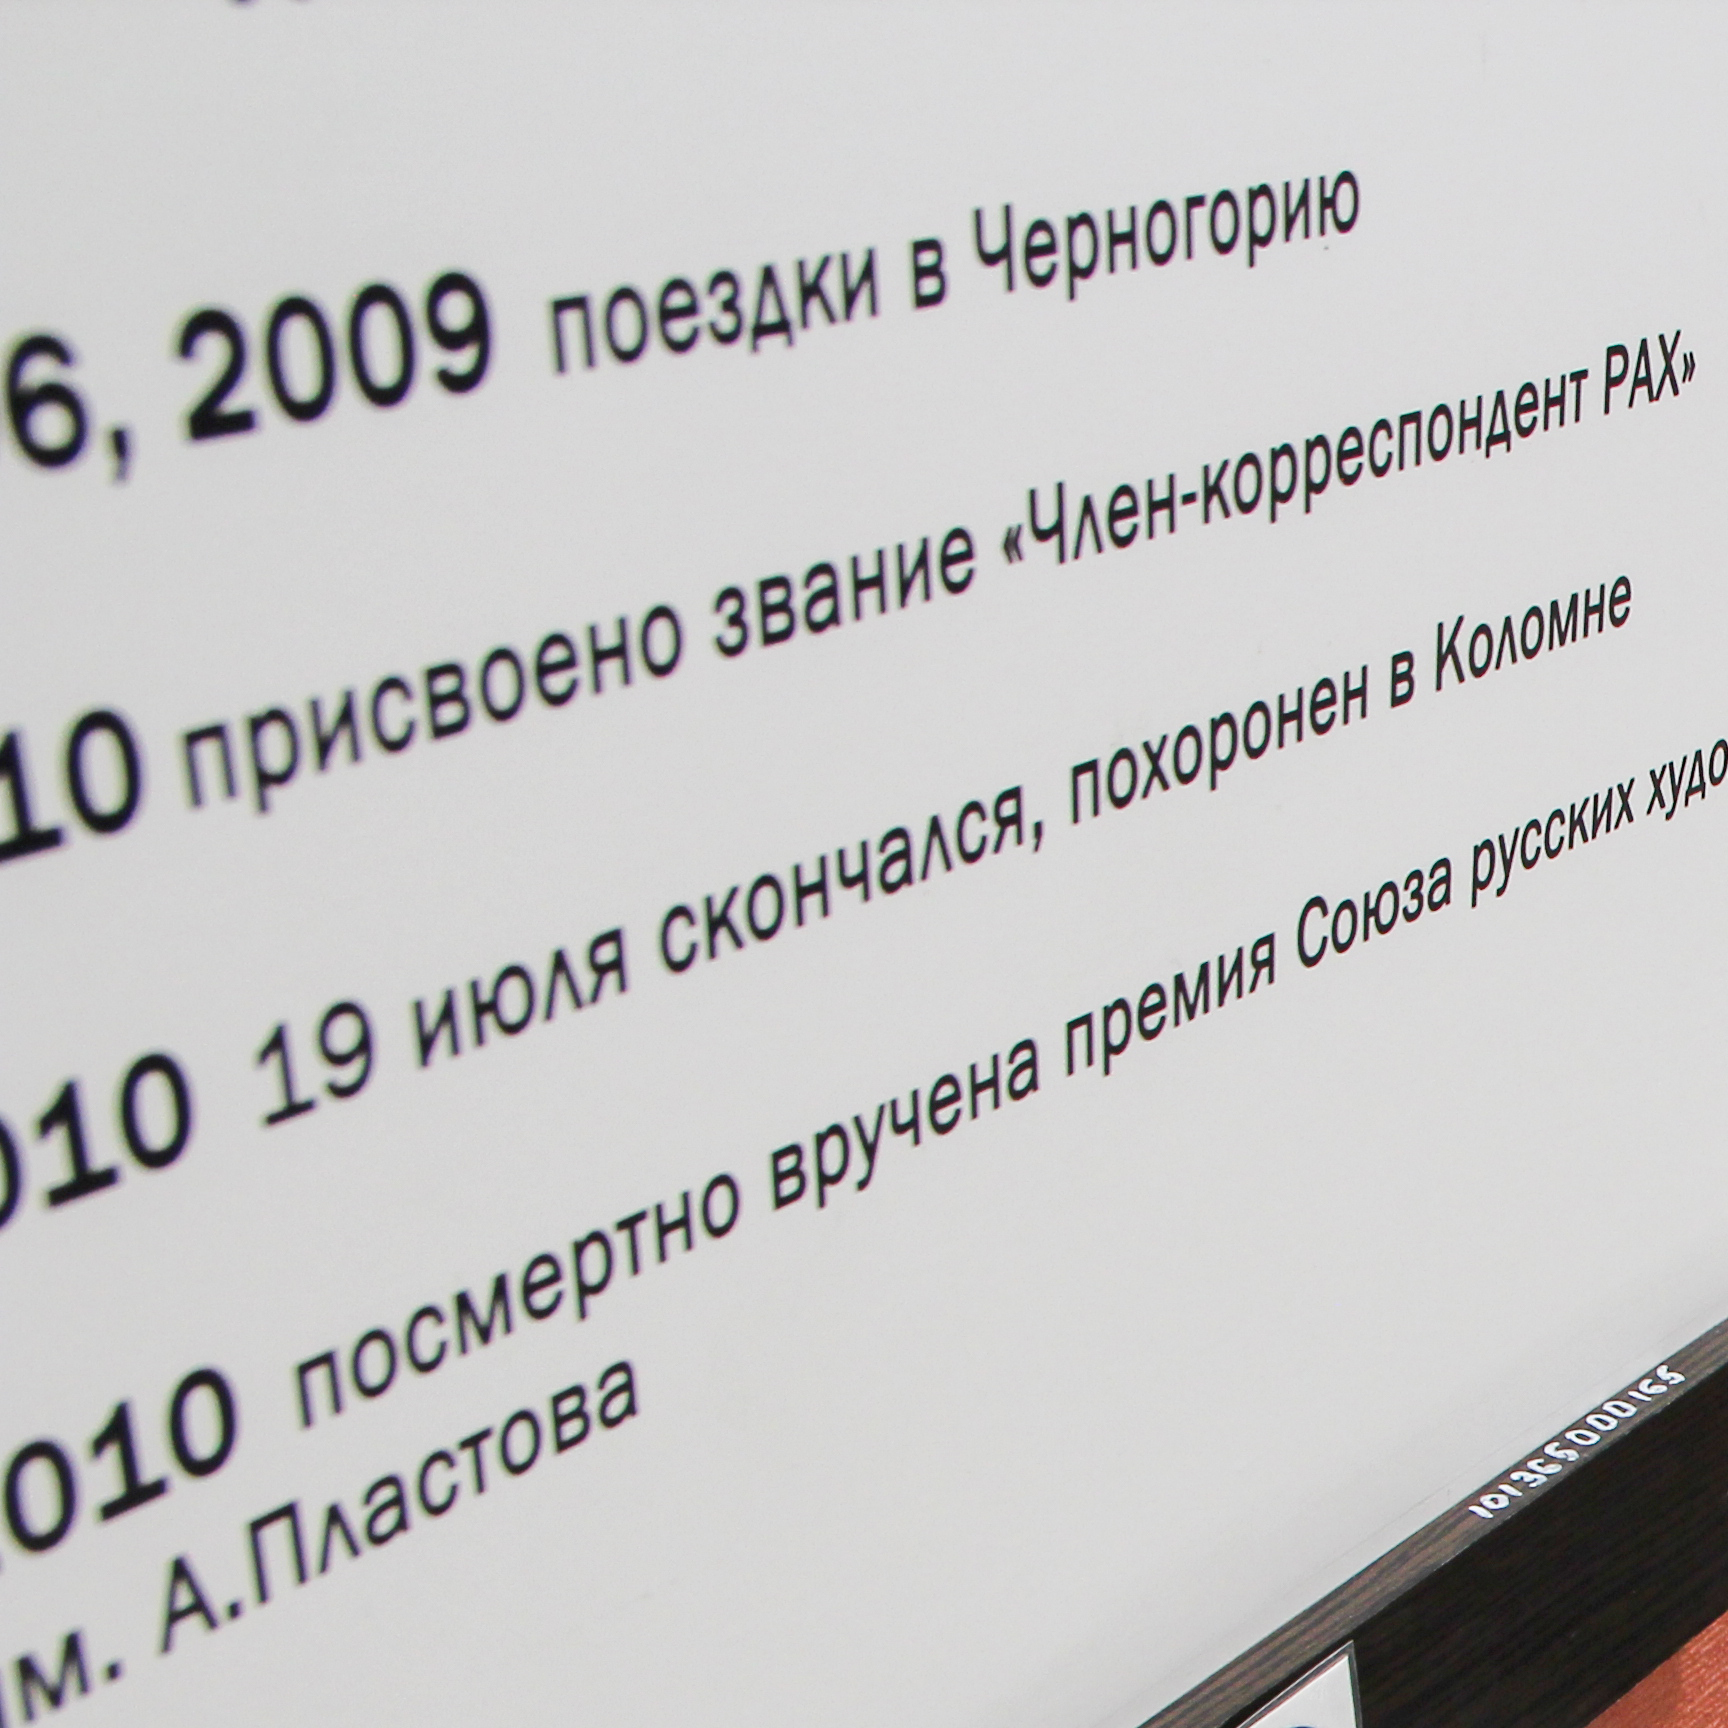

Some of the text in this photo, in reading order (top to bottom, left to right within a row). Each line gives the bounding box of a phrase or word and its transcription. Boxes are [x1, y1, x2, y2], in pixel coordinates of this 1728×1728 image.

[176, 271, 494, 440] 2009
[549, 248, 880, 375] поездки
[910, 238, 948, 310] в
[974, 170, 1359, 299] Черногорию
[182, 604, 684, 813] присвоено
[713, 527, 977, 658] звание
[1002, 368, 1588, 565] «Член-корреспондент
[1603, 330, 1696, 416] РАХ»
[0, 574, 1631, 1232] 10 19 июля скончался, похоронен в Коломне
[295, 1171, 740, 1430] посмертно
[769, 1038, 1042, 1209] вручена
[1064, 932, 1276, 1078] премия
[1298, 853, 1451, 968] Союза
[1470, 772, 1634, 908] русских
[157, 1358, 638, 1653] А.Пластова
